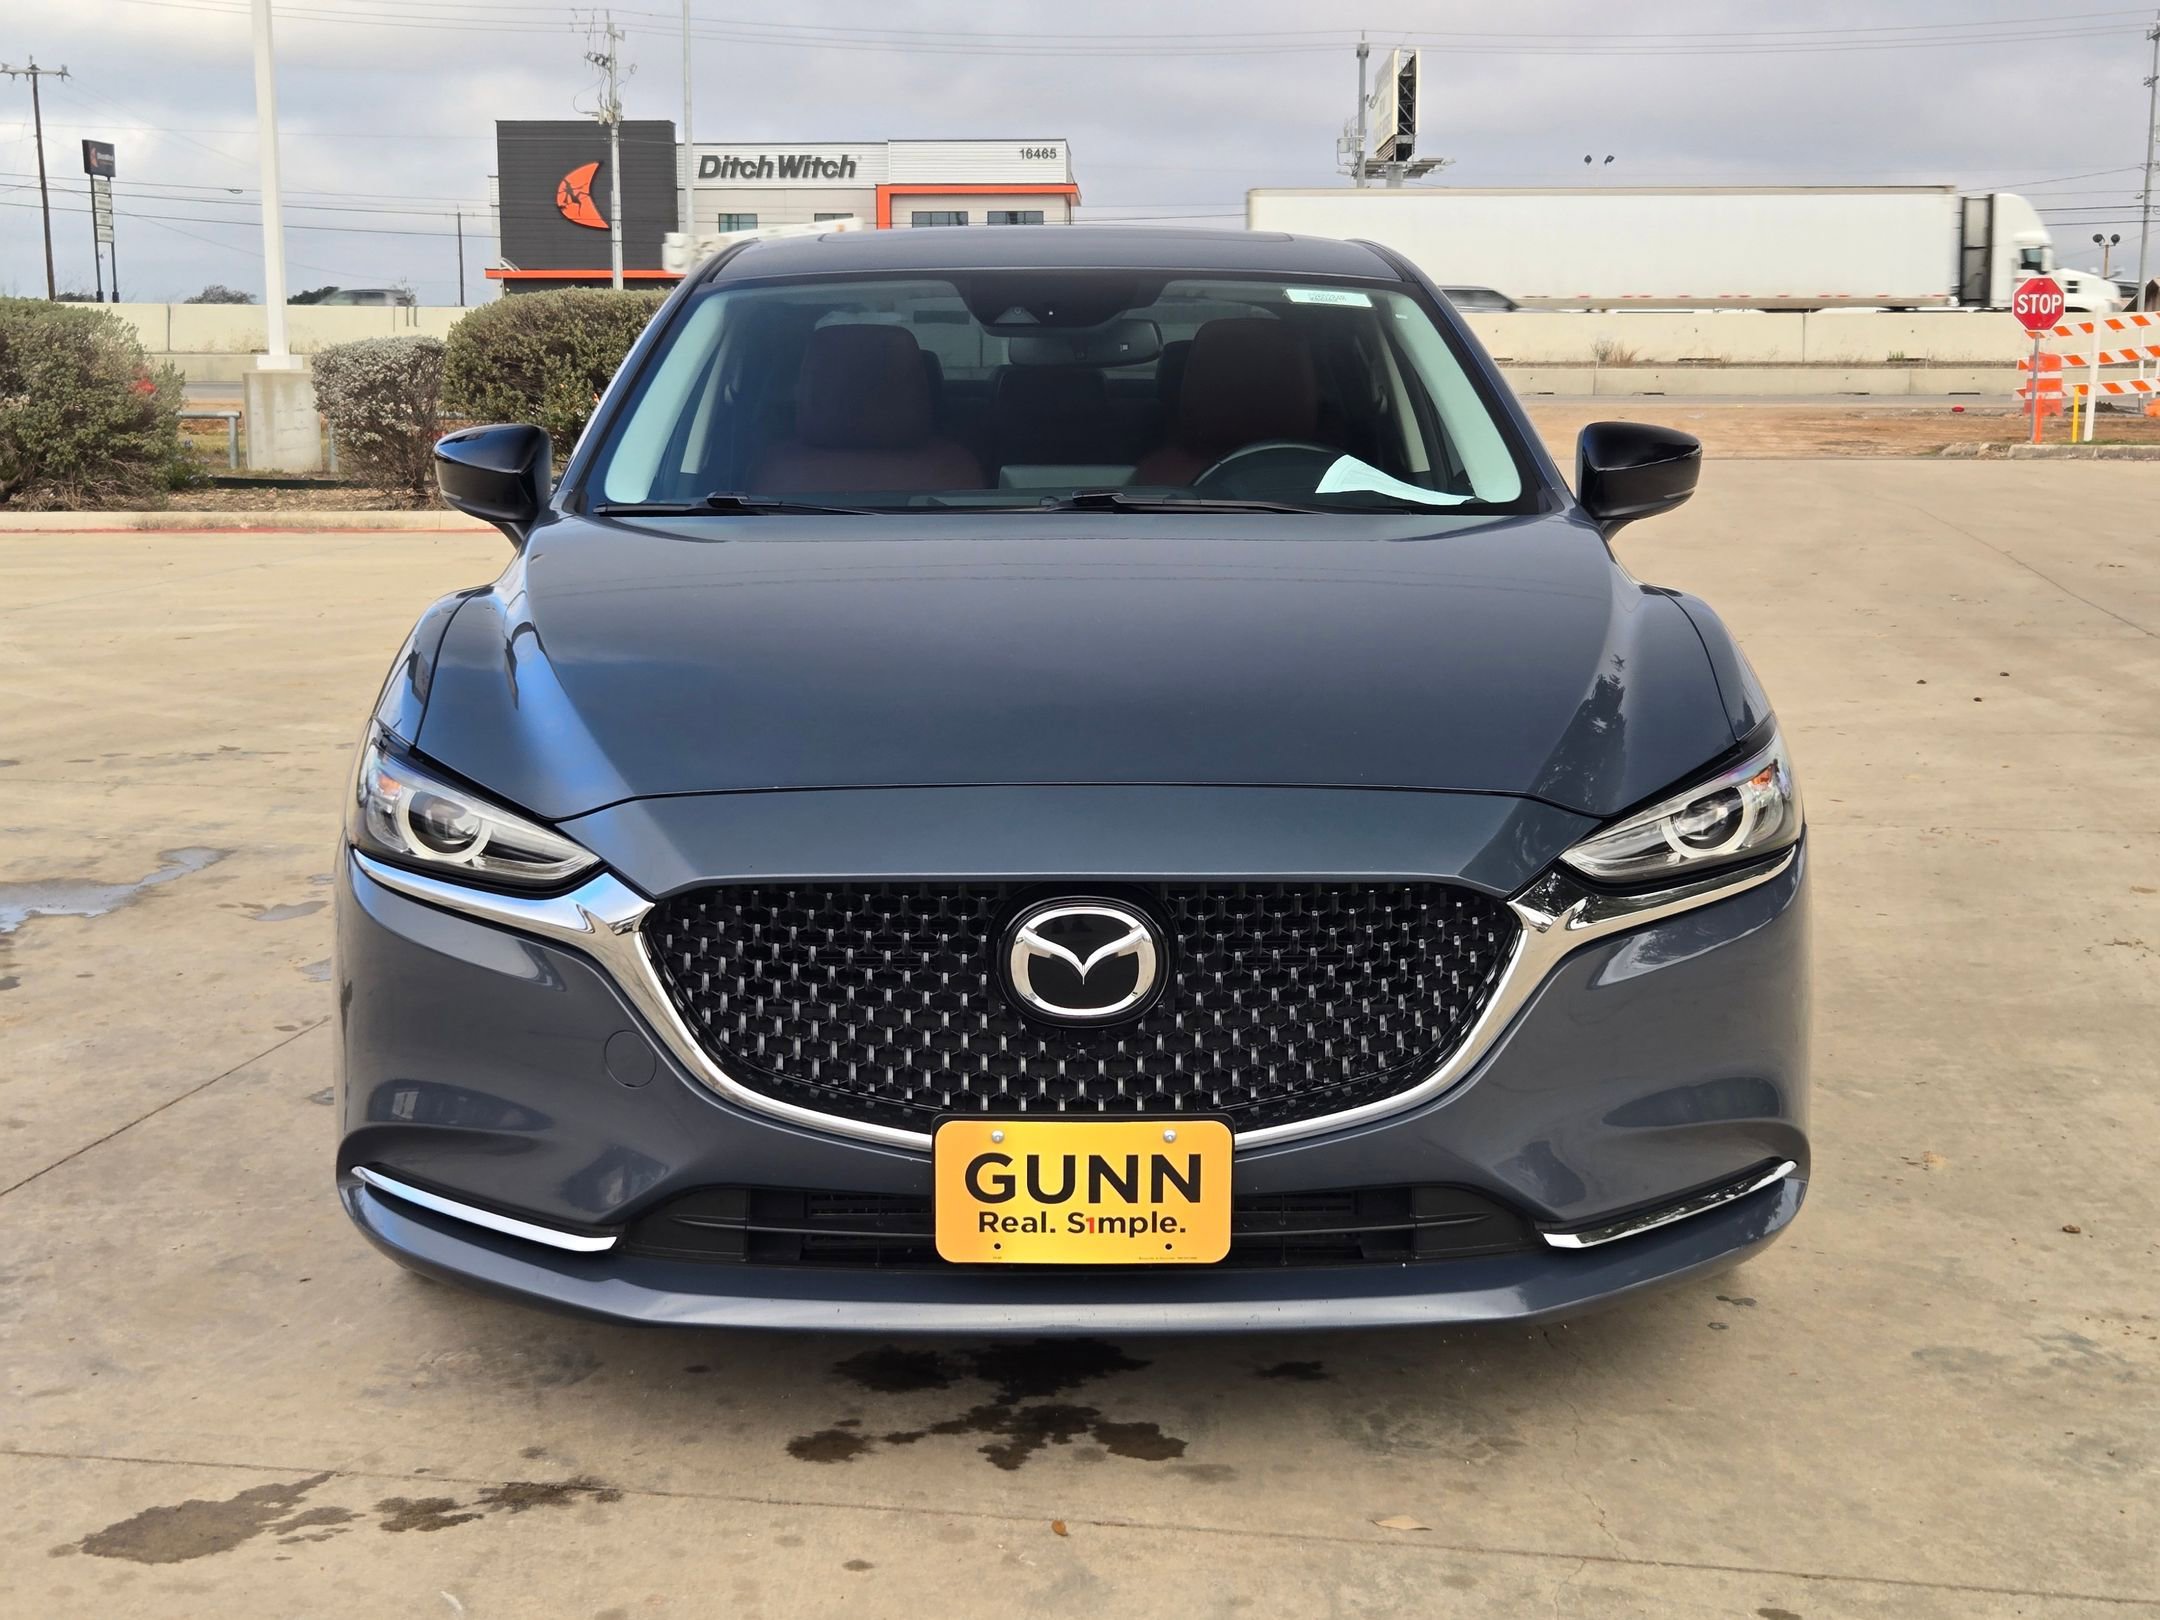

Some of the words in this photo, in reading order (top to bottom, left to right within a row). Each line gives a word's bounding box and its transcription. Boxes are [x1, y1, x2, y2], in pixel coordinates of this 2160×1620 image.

[1019, 147, 1057, 160] 16465
[698, 154, 774, 178] Ditch
[778, 154, 857, 178] Witch
[2016, 293, 2062, 315] STOP
[964, 1152, 1202, 1204] GUNN
[978, 1211, 1056, 1234] Real.
